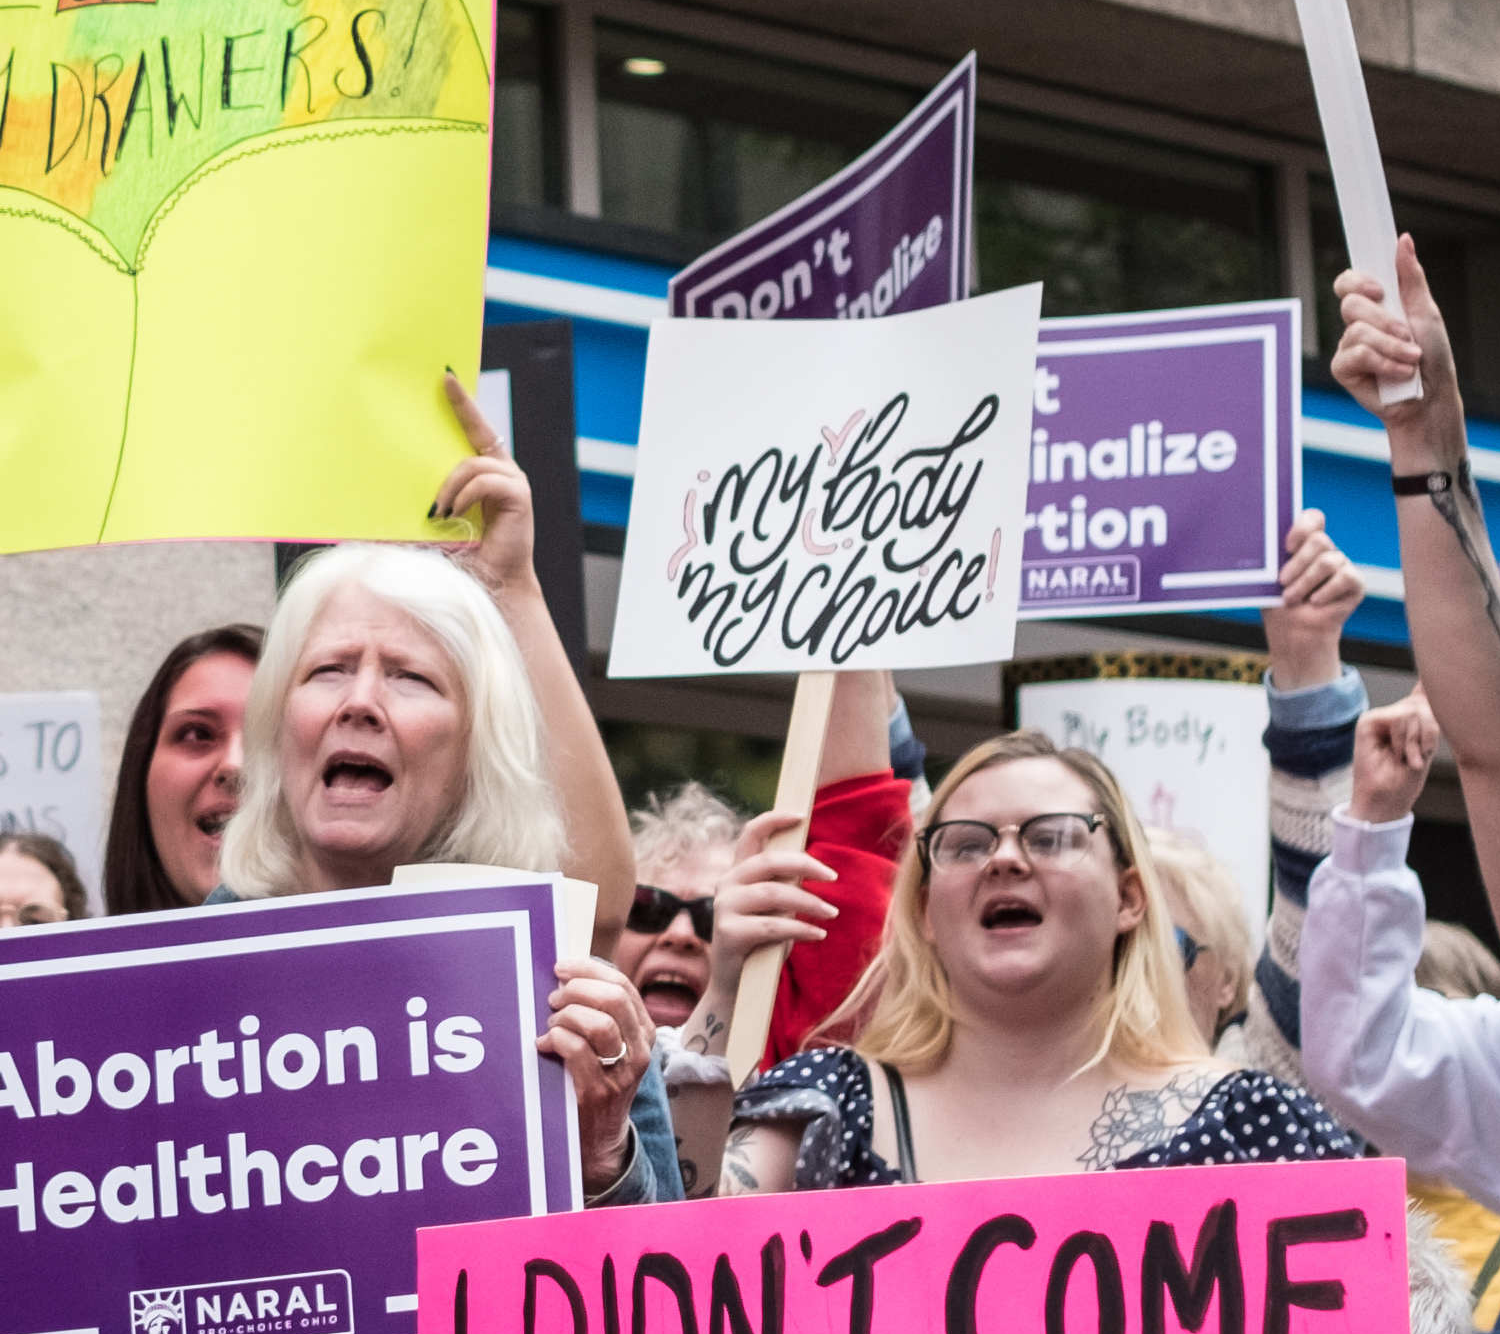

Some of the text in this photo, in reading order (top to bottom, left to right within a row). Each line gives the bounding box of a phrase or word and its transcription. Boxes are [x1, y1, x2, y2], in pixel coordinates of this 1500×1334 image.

[1028, 565, 1128, 588] NARAL
[24, 720, 83, 773] TO
[406, 994, 486, 1081] is
[196, 1283, 337, 1325] NARAL
[300, 1315, 338, 1327] OHIO
